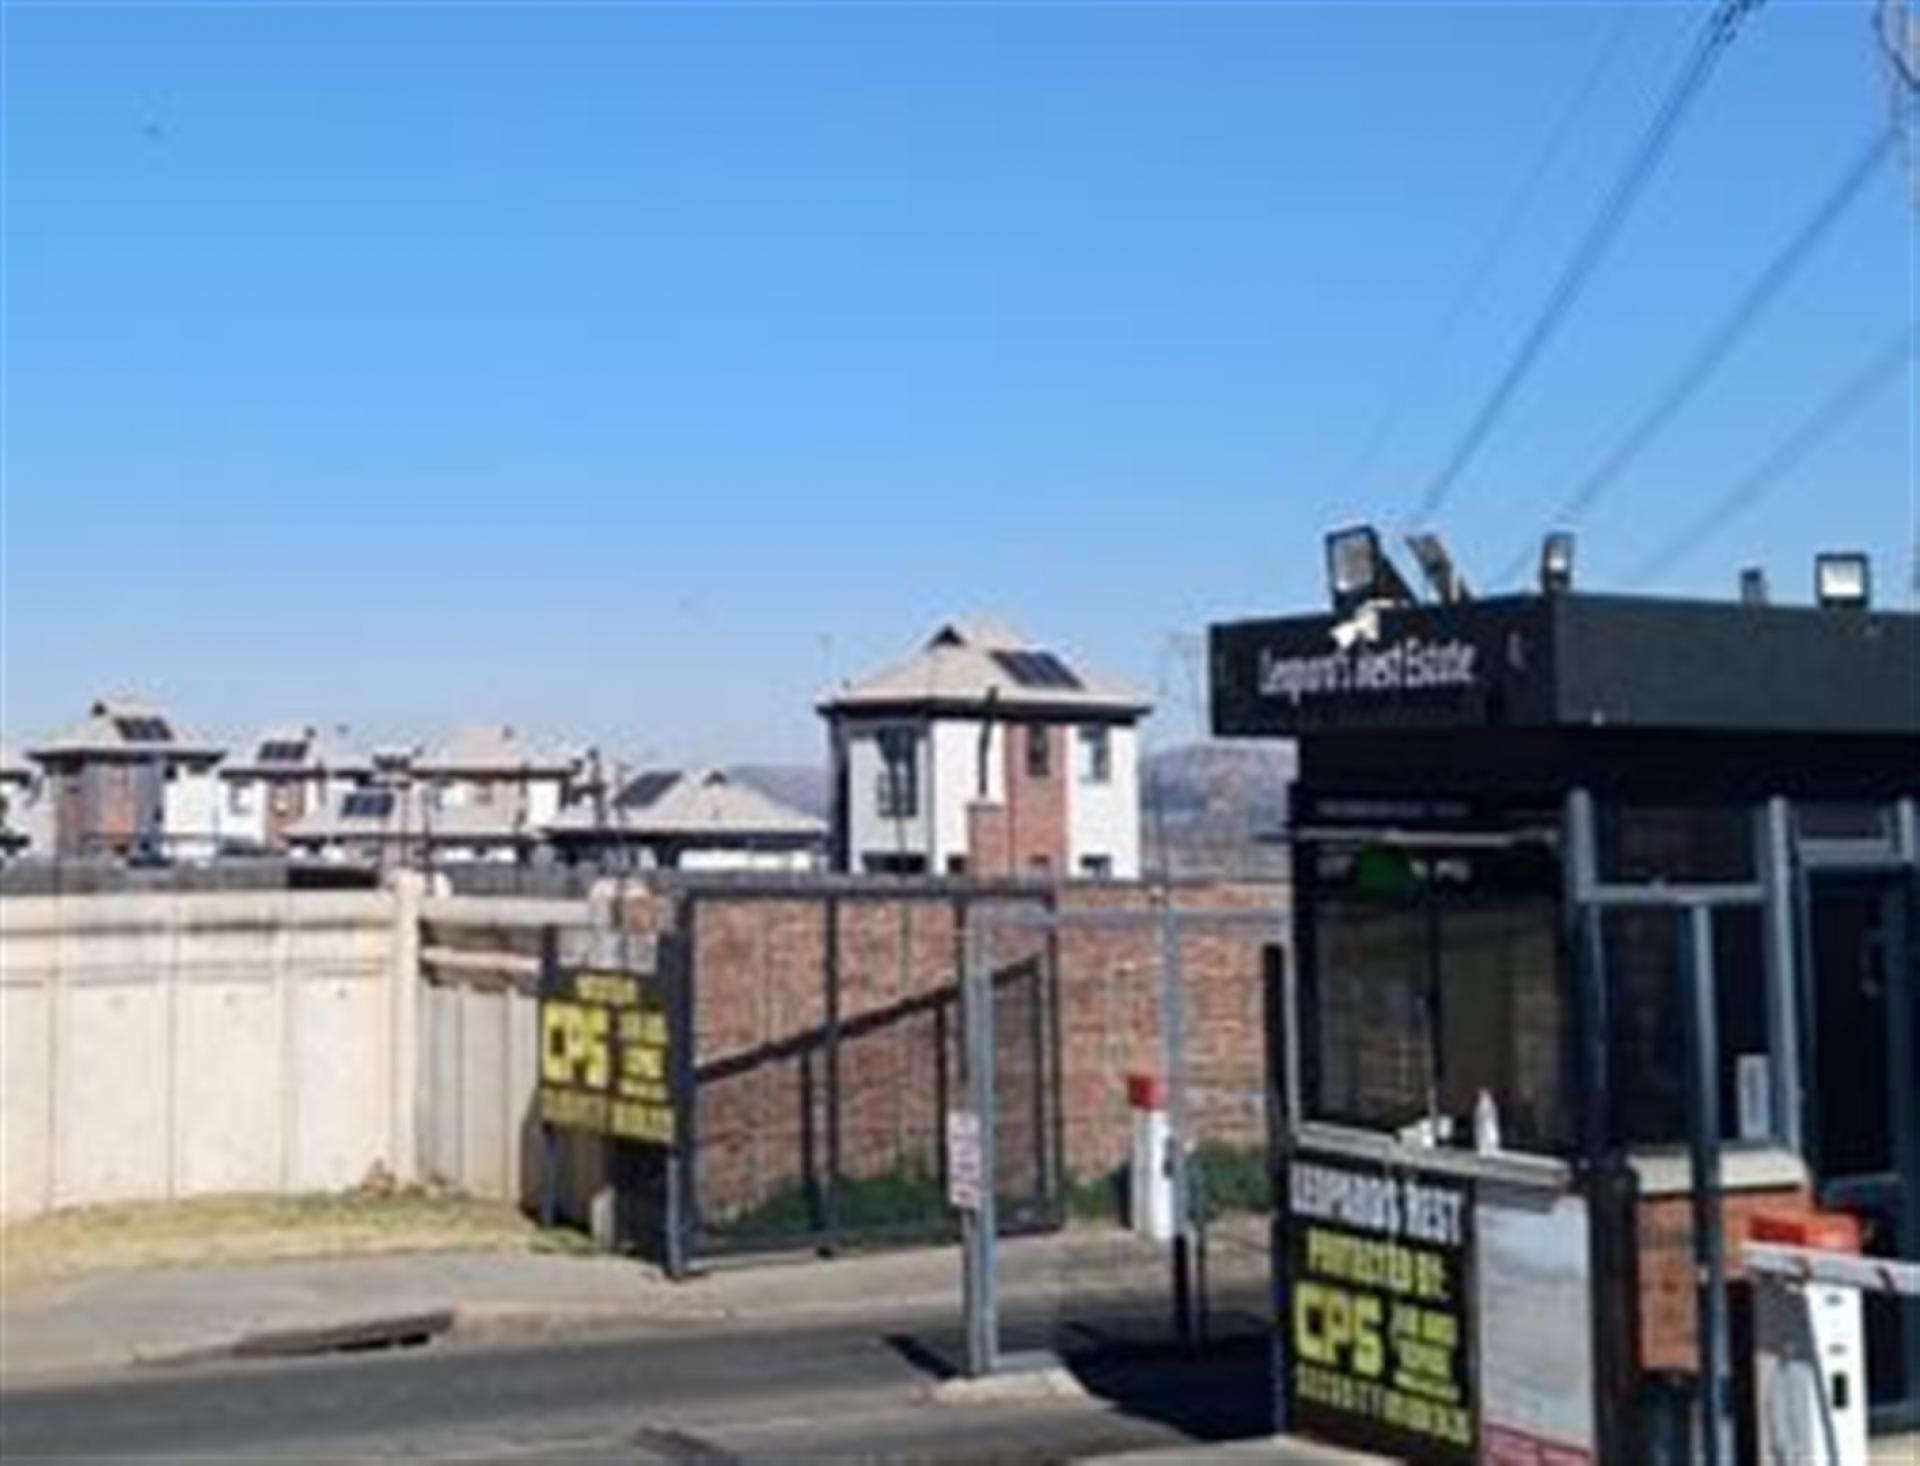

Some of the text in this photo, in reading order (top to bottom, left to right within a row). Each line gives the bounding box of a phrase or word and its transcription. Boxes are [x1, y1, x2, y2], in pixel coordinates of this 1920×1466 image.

[1406, 635, 1477, 687] Estate
[543, 1000, 609, 1088] CPS
[1404, 1181, 1463, 1245] REST
[1294, 1282, 1384, 1377] CPS
